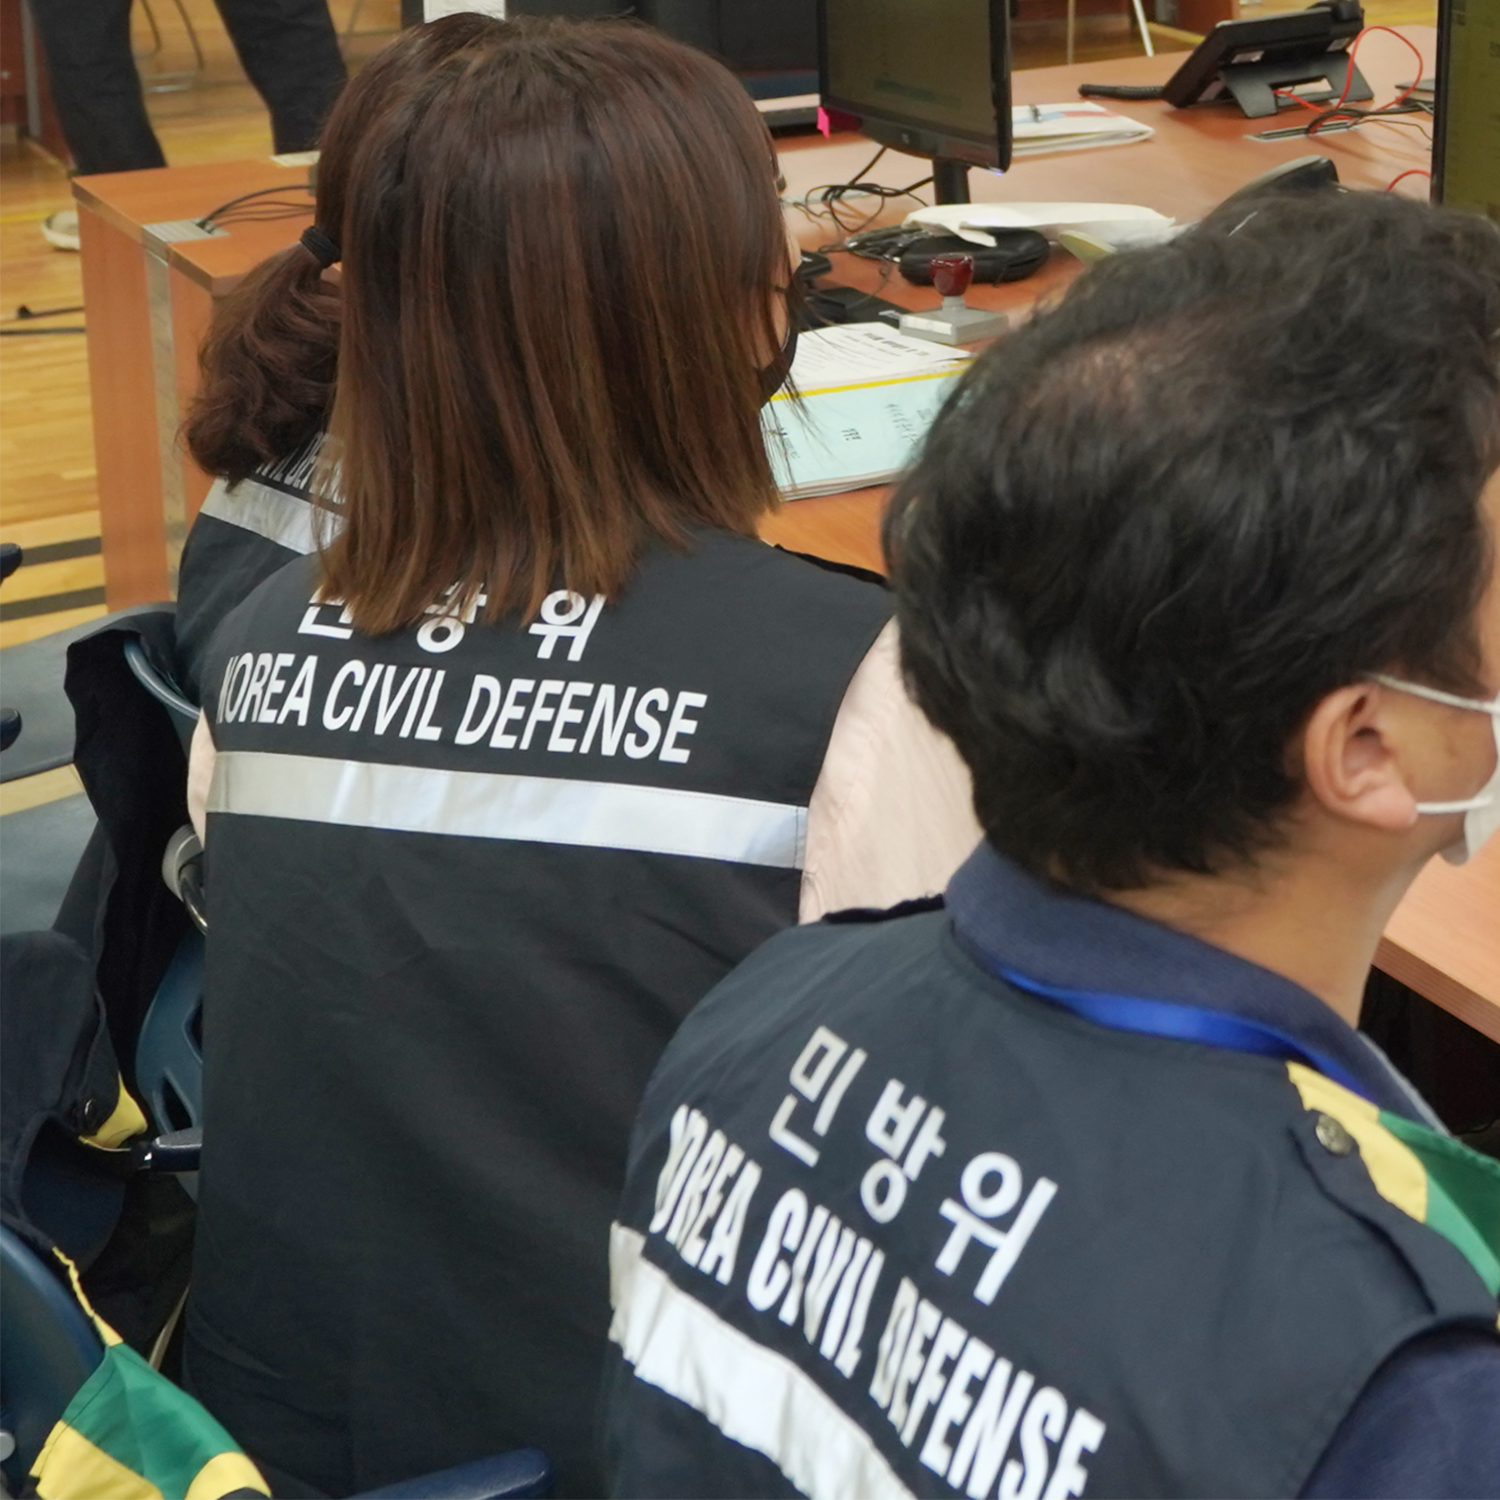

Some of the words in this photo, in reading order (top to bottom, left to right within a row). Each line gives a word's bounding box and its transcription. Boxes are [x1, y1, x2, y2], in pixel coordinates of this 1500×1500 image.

[322, 658, 447, 742] CIVIL
[454, 673, 709, 765] DEFENSE
[746, 1187, 886, 1380] CIVIL
[868, 1275, 1107, 1500] DEFENSE
